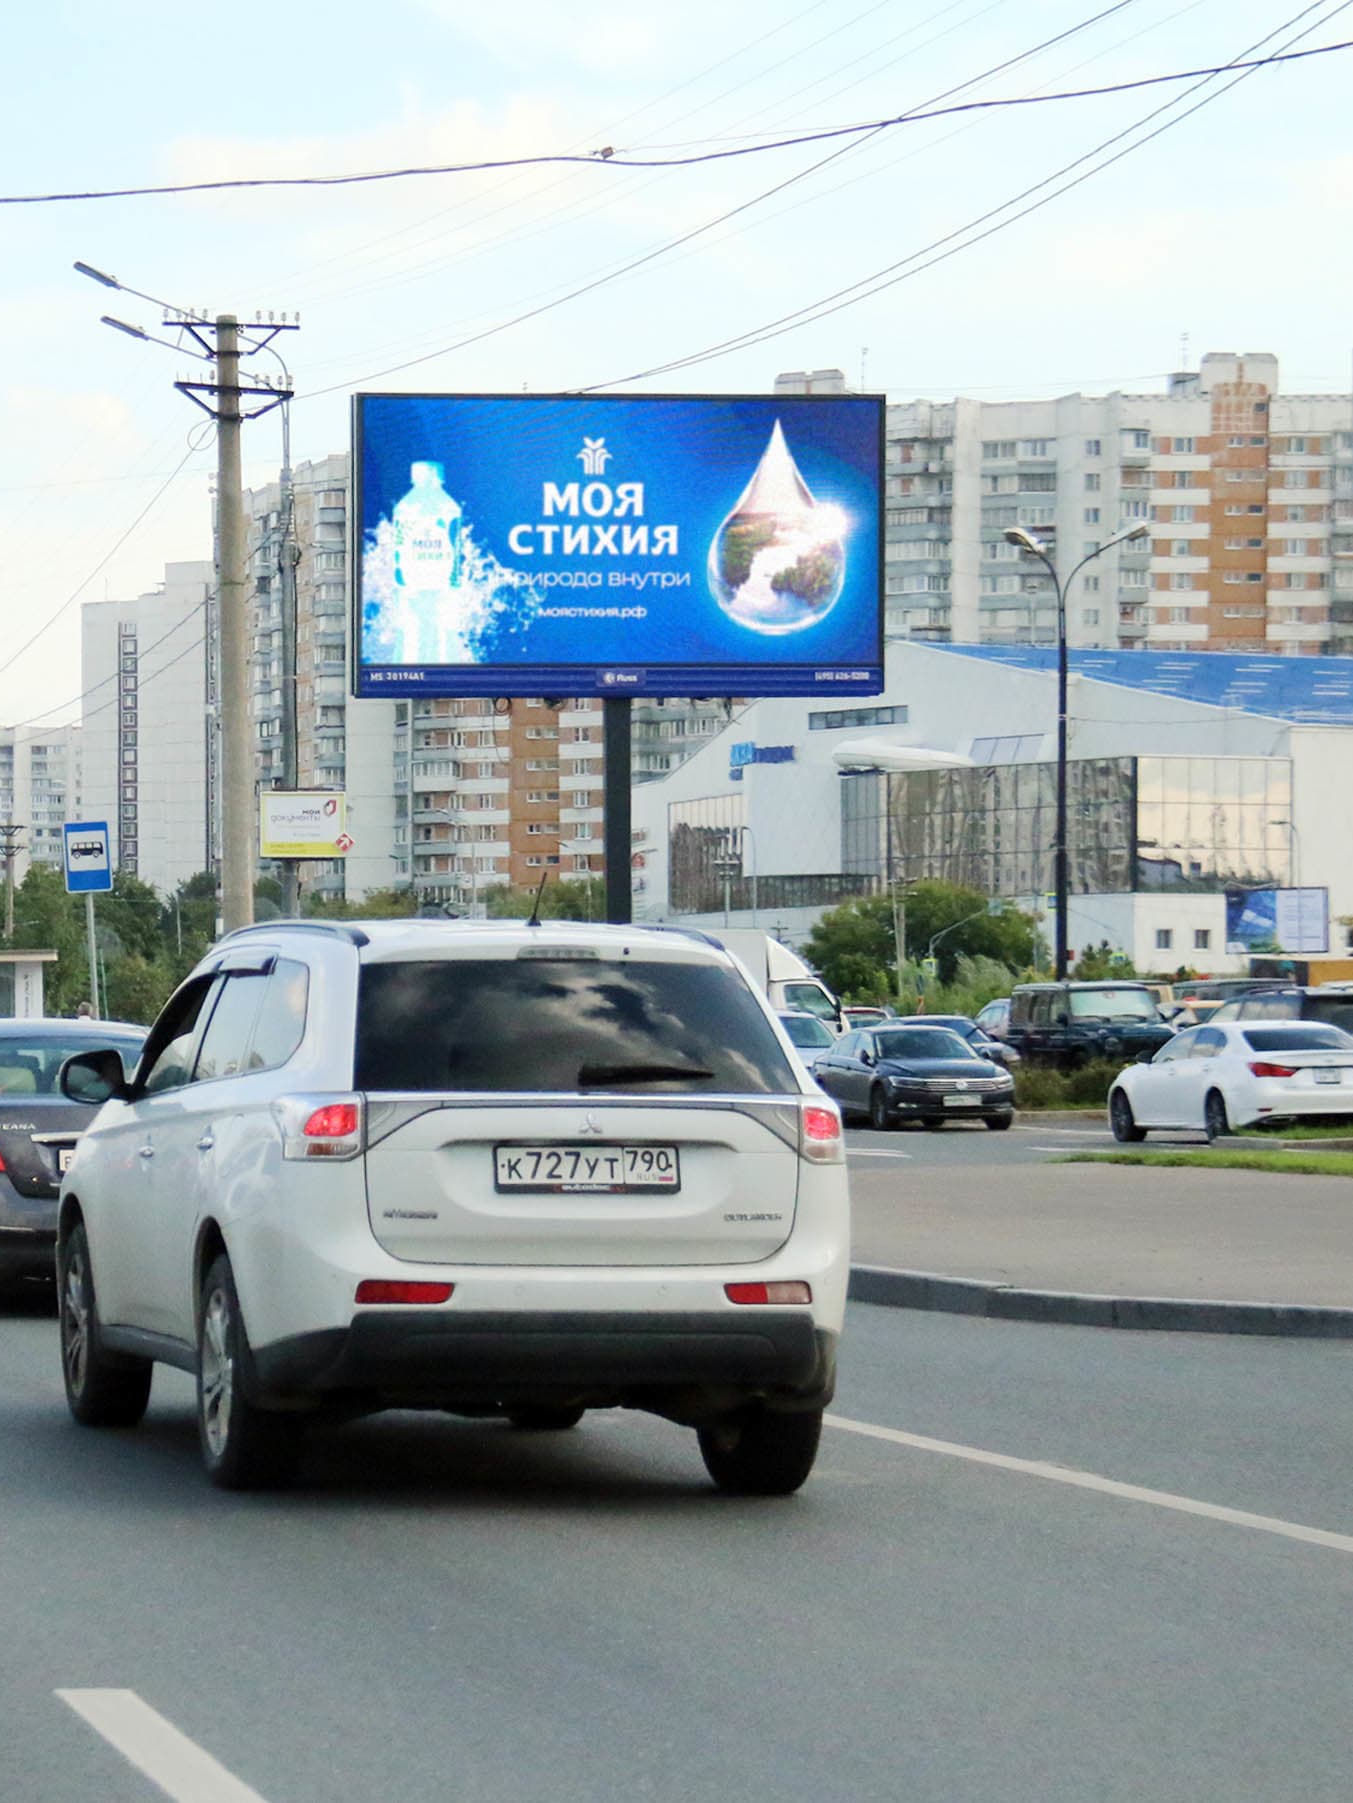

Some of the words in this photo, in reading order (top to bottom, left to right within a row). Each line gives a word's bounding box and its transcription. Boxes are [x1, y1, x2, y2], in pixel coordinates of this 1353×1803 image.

[542, 482, 644, 518] МОЯ
[508, 524, 679, 556] СТИХИЯ
[496, 570, 603, 590] рирода
[607, 570, 692, 591] внутри
[506, 1151, 619, 1180] К727УТ
[625, 1150, 670, 1173] 790
